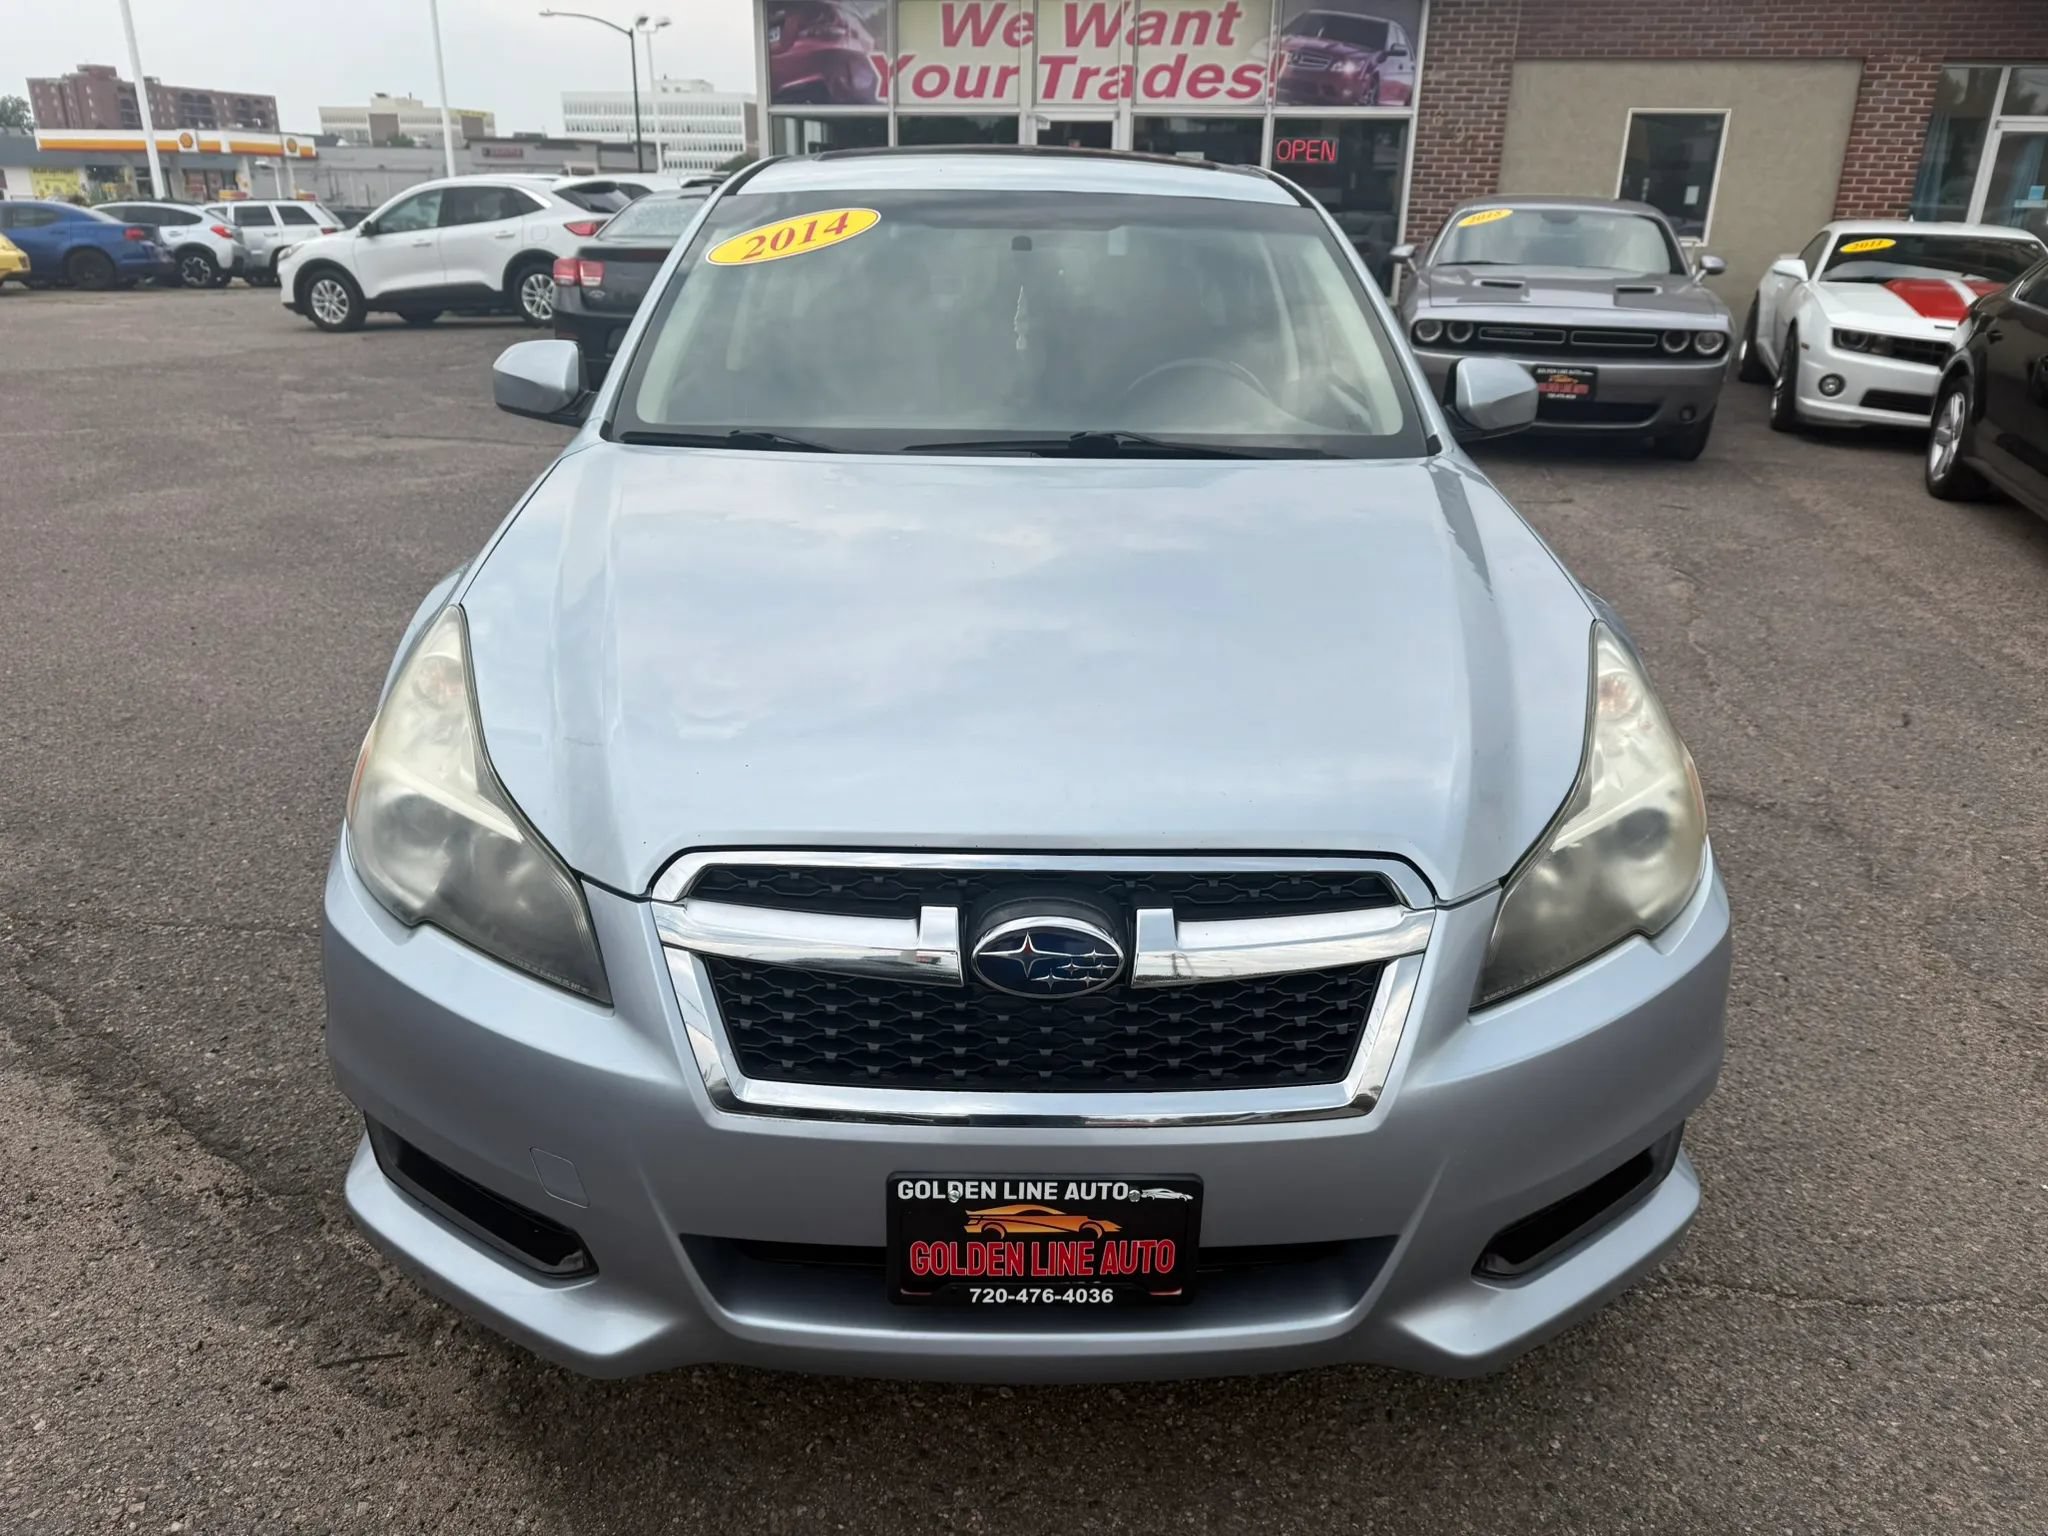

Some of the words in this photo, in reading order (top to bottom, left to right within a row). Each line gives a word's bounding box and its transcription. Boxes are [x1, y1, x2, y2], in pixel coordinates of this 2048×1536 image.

[941, 2, 1034, 47] We
[1064, 2, 1241, 47] Want
[870, 53, 1020, 99] Your
[1039, 50, 1287, 99] Trades!
[1275, 139, 1337, 162] OPEN
[741, 212, 849, 260] 2014
[897, 1180, 996, 1201] GOLDEN
[1004, 1181, 1059, 1201] LINE
[1064, 1181, 1129, 1201] AUTO
[909, 1241, 1024, 1278] GOLDEN
[1030, 1240, 1094, 1277] LINE
[1099, 1238, 1176, 1275] AUTO
[969, 1288, 1115, 1304] 720-476-4036
